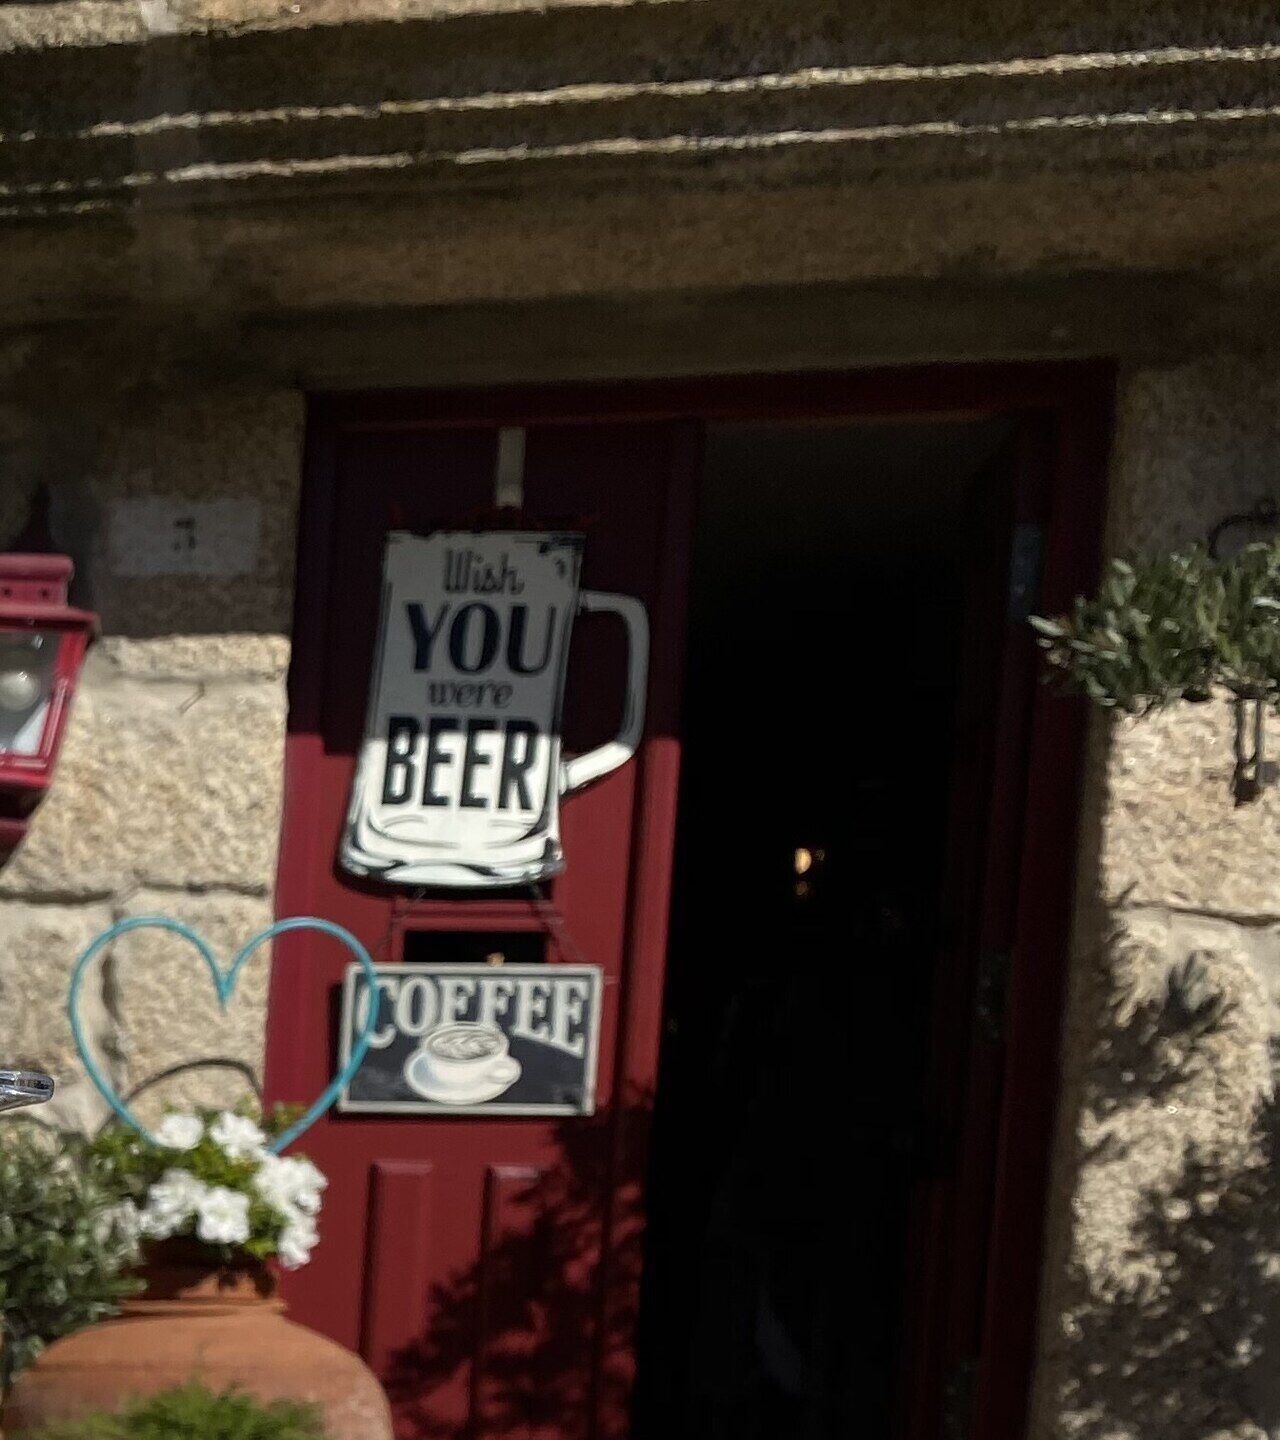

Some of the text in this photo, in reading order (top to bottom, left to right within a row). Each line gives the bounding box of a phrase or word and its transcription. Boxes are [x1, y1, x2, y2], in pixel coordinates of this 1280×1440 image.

[443, 547, 526, 597] Wish
[404, 602, 559, 675] YOU
[429, 677, 514, 710] were
[381, 715, 542, 812] BEER
[362, 974, 590, 1057] COFFEE
